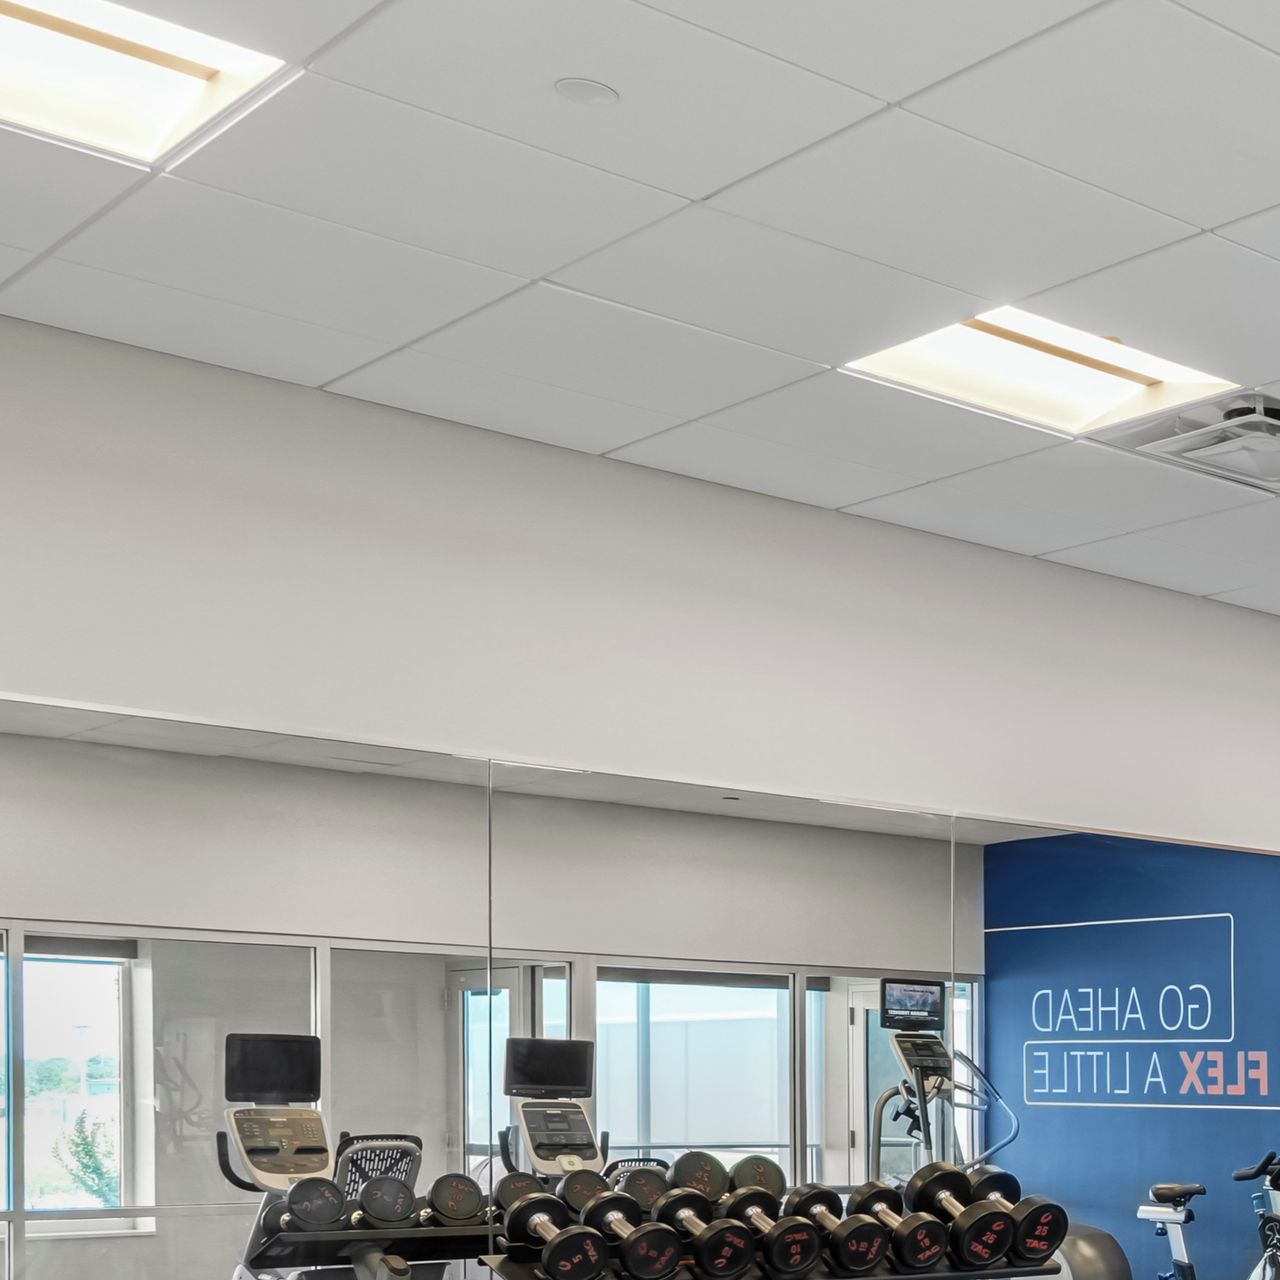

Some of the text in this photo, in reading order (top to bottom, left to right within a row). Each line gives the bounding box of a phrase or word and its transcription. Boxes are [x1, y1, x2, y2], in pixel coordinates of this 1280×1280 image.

[981, 1231, 997, 1245] 25
[1033, 1225, 1049, 1237] 25
[969, 1240, 991, 1260] TAG
[1024, 1237, 1050, 1251] TAG
